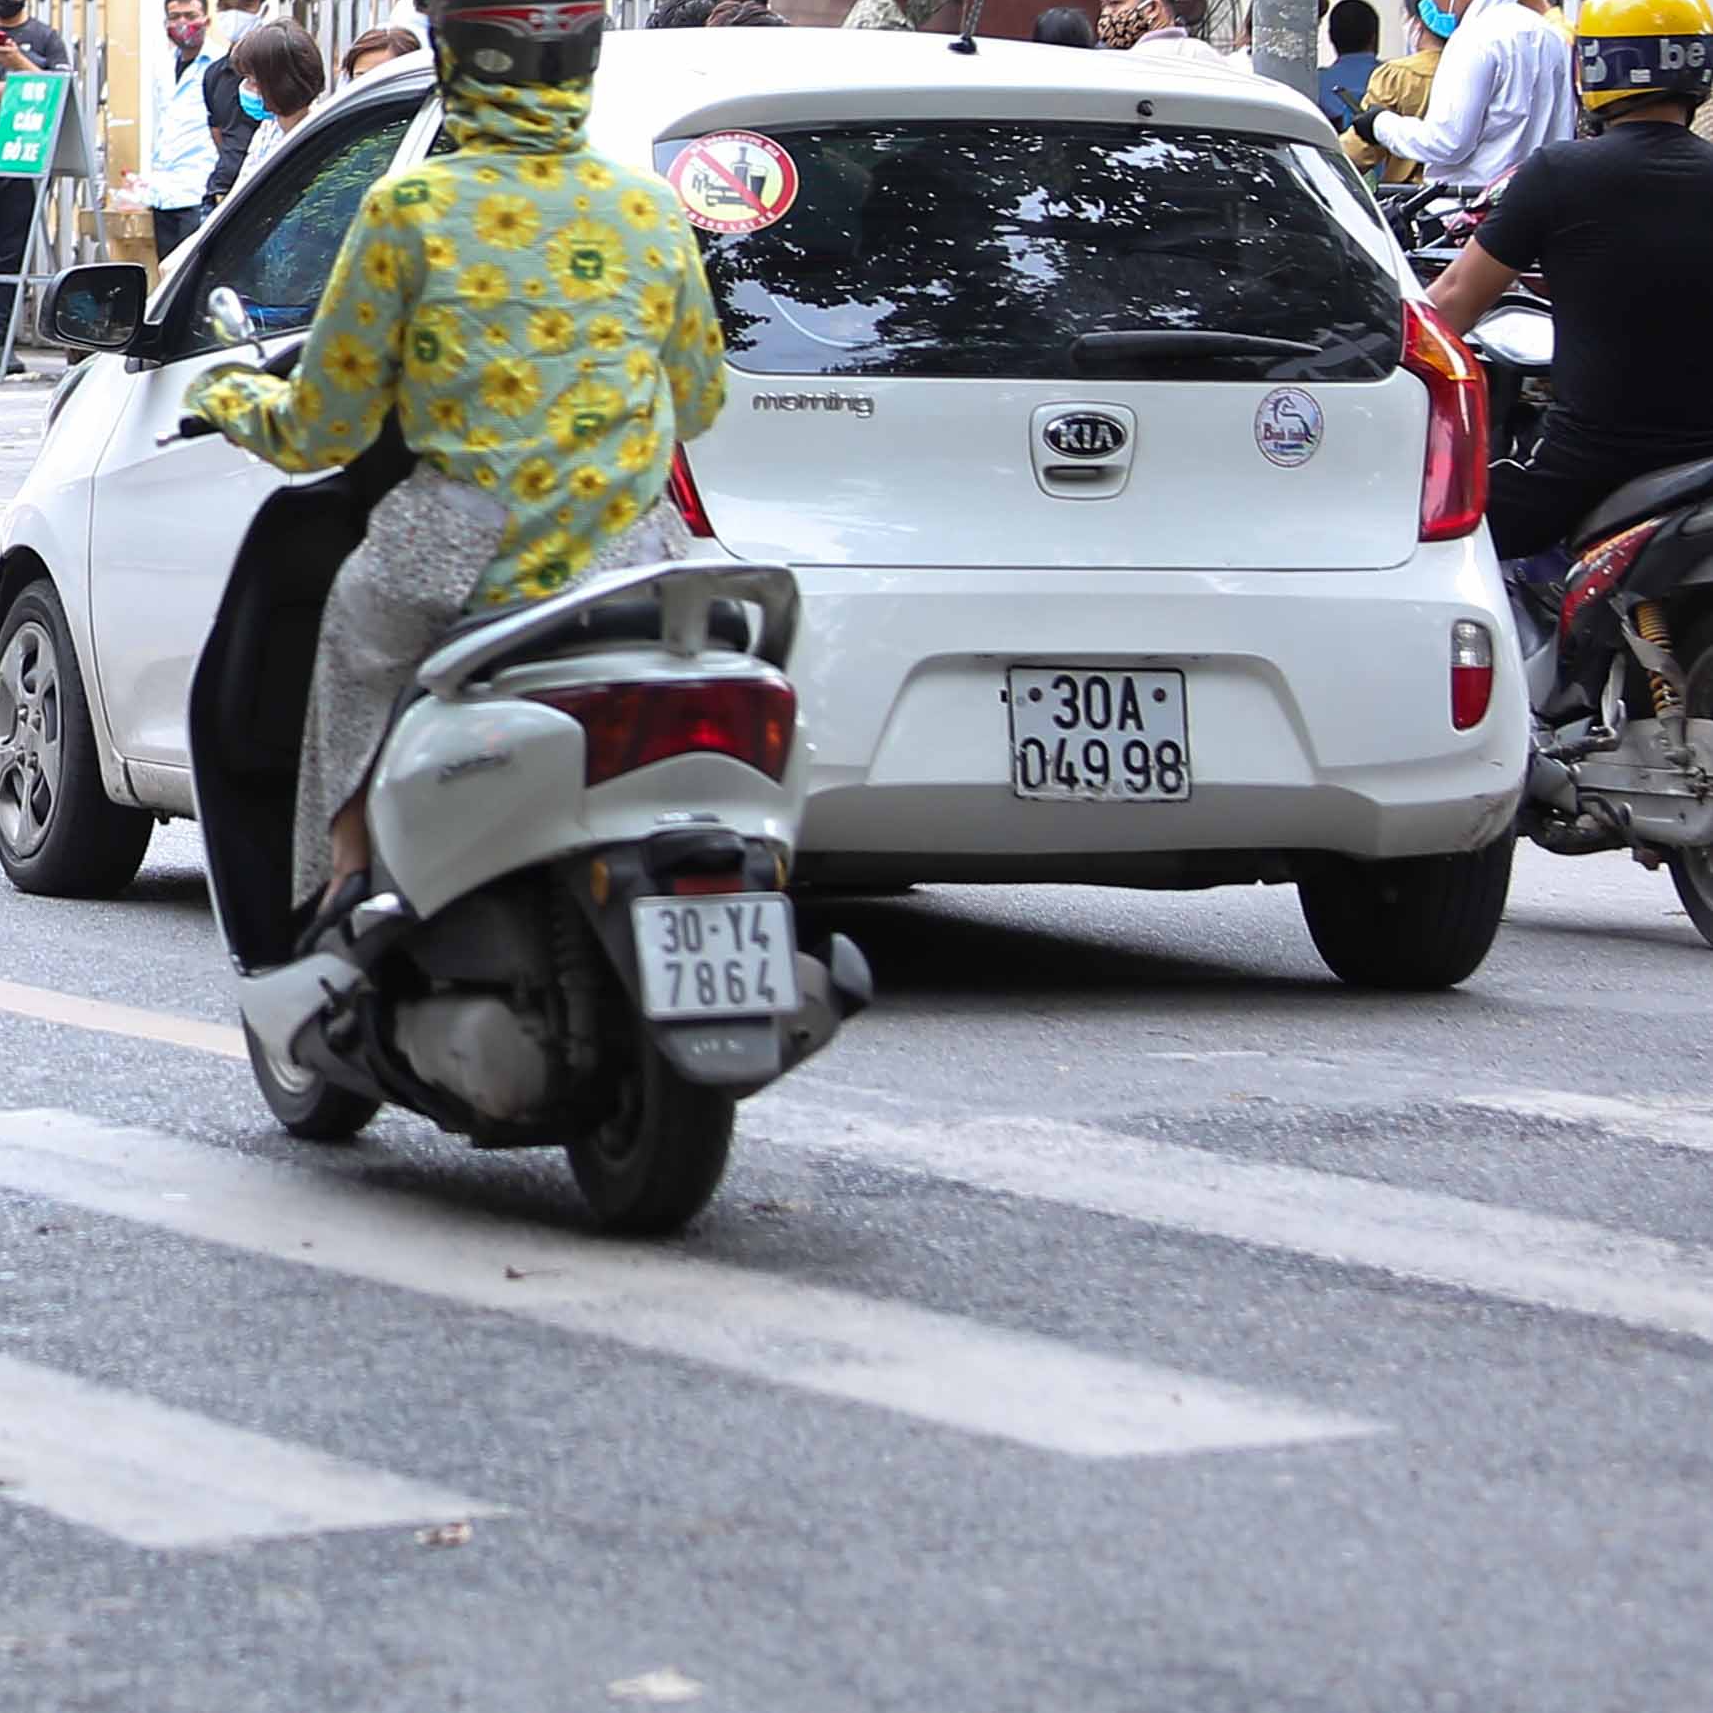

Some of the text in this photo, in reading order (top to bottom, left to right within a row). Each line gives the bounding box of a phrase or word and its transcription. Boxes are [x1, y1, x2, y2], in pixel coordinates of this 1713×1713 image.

[1659, 38, 1706, 70] be
[752, 390, 874, 418] morning
[1058, 423, 1114, 449] KIA
[1051, 675, 1144, 731] 30A
[659, 905, 769, 954] 30-Y4
[665, 959, 775, 1006] 7864
